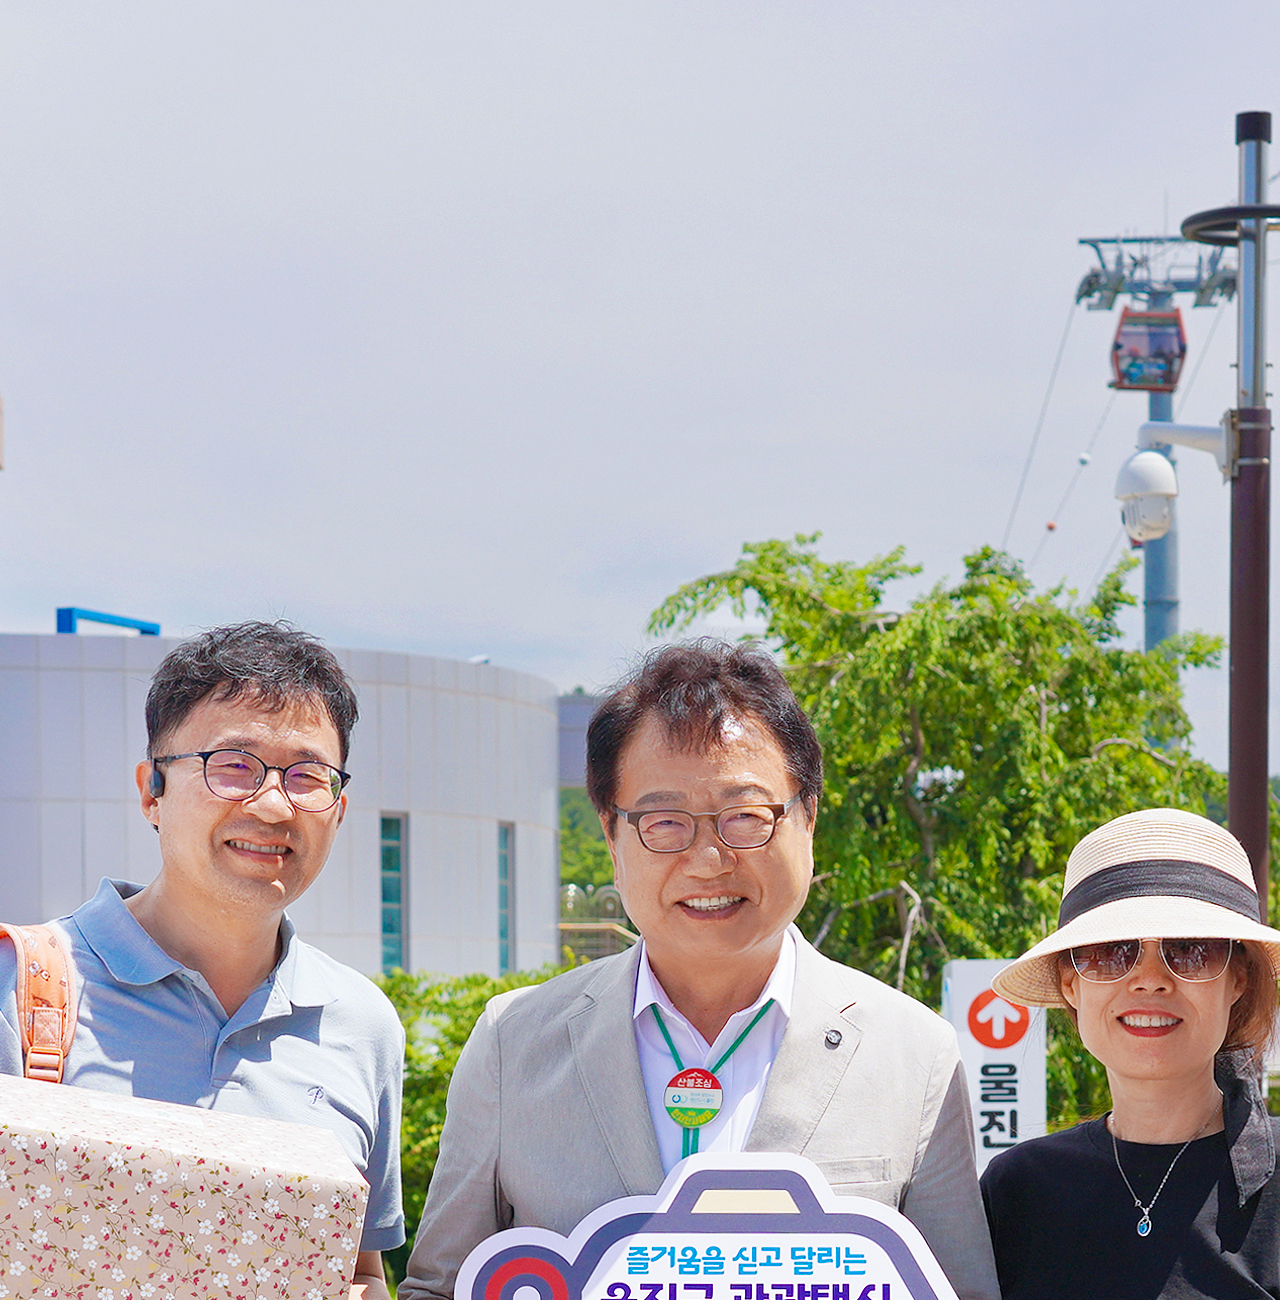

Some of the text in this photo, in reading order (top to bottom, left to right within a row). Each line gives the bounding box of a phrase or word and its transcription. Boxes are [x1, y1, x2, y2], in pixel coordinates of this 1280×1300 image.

[979, 1063, 1018, 1149] 울진
[626, 1246, 867, 1275] 즐거움을 싣고 달리는
